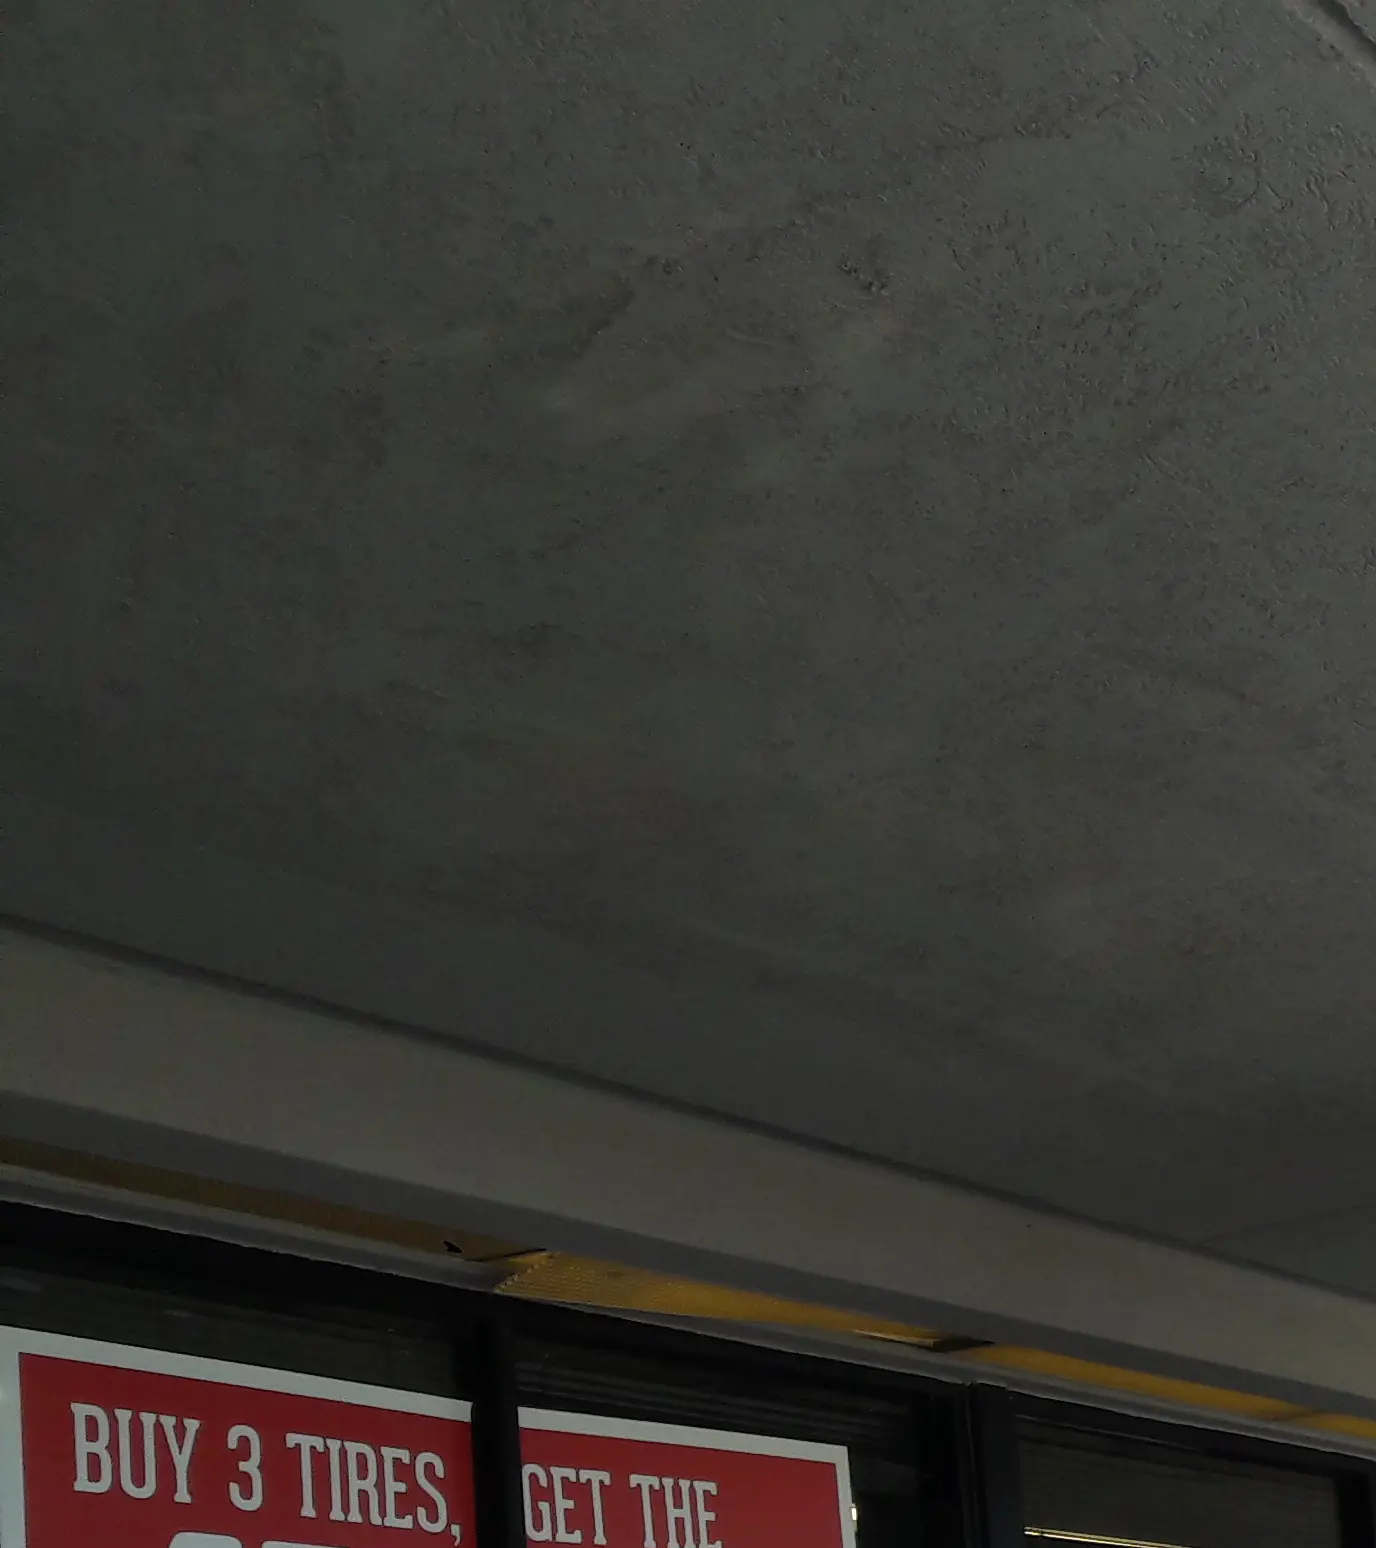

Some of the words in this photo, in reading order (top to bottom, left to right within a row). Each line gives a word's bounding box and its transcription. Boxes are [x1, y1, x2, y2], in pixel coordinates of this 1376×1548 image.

[70, 1401, 202, 1505] BUY
[228, 1424, 265, 1512] 3
[286, 1432, 462, 1547] TIRES,
[522, 1462, 611, 1546] GET
